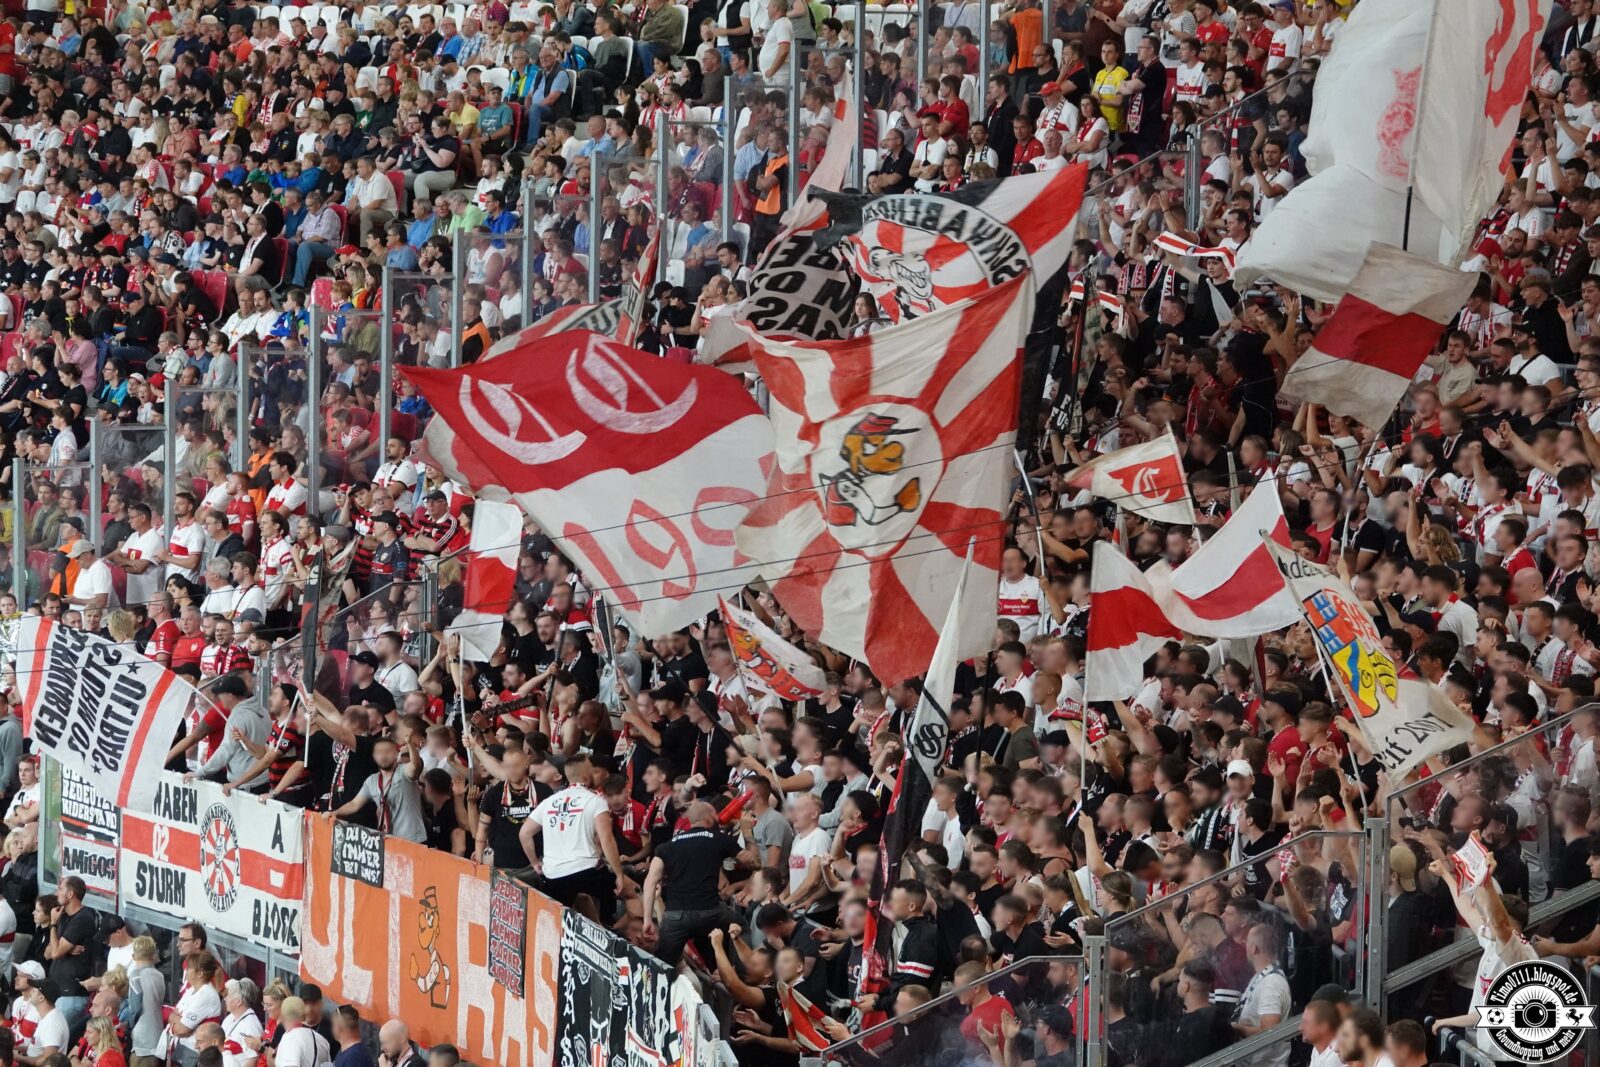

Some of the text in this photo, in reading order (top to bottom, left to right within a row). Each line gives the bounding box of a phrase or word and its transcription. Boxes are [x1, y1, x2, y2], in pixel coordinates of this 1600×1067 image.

[152, 823, 170, 862] 02
[272, 813, 284, 853] A
[346, 827, 359, 841] DU
[342, 842, 380, 869] IMMER
[343, 861, 381, 884] BEI UNS!
[135, 860, 187, 908] STURM
[252, 899, 299, 948] BLOCK
